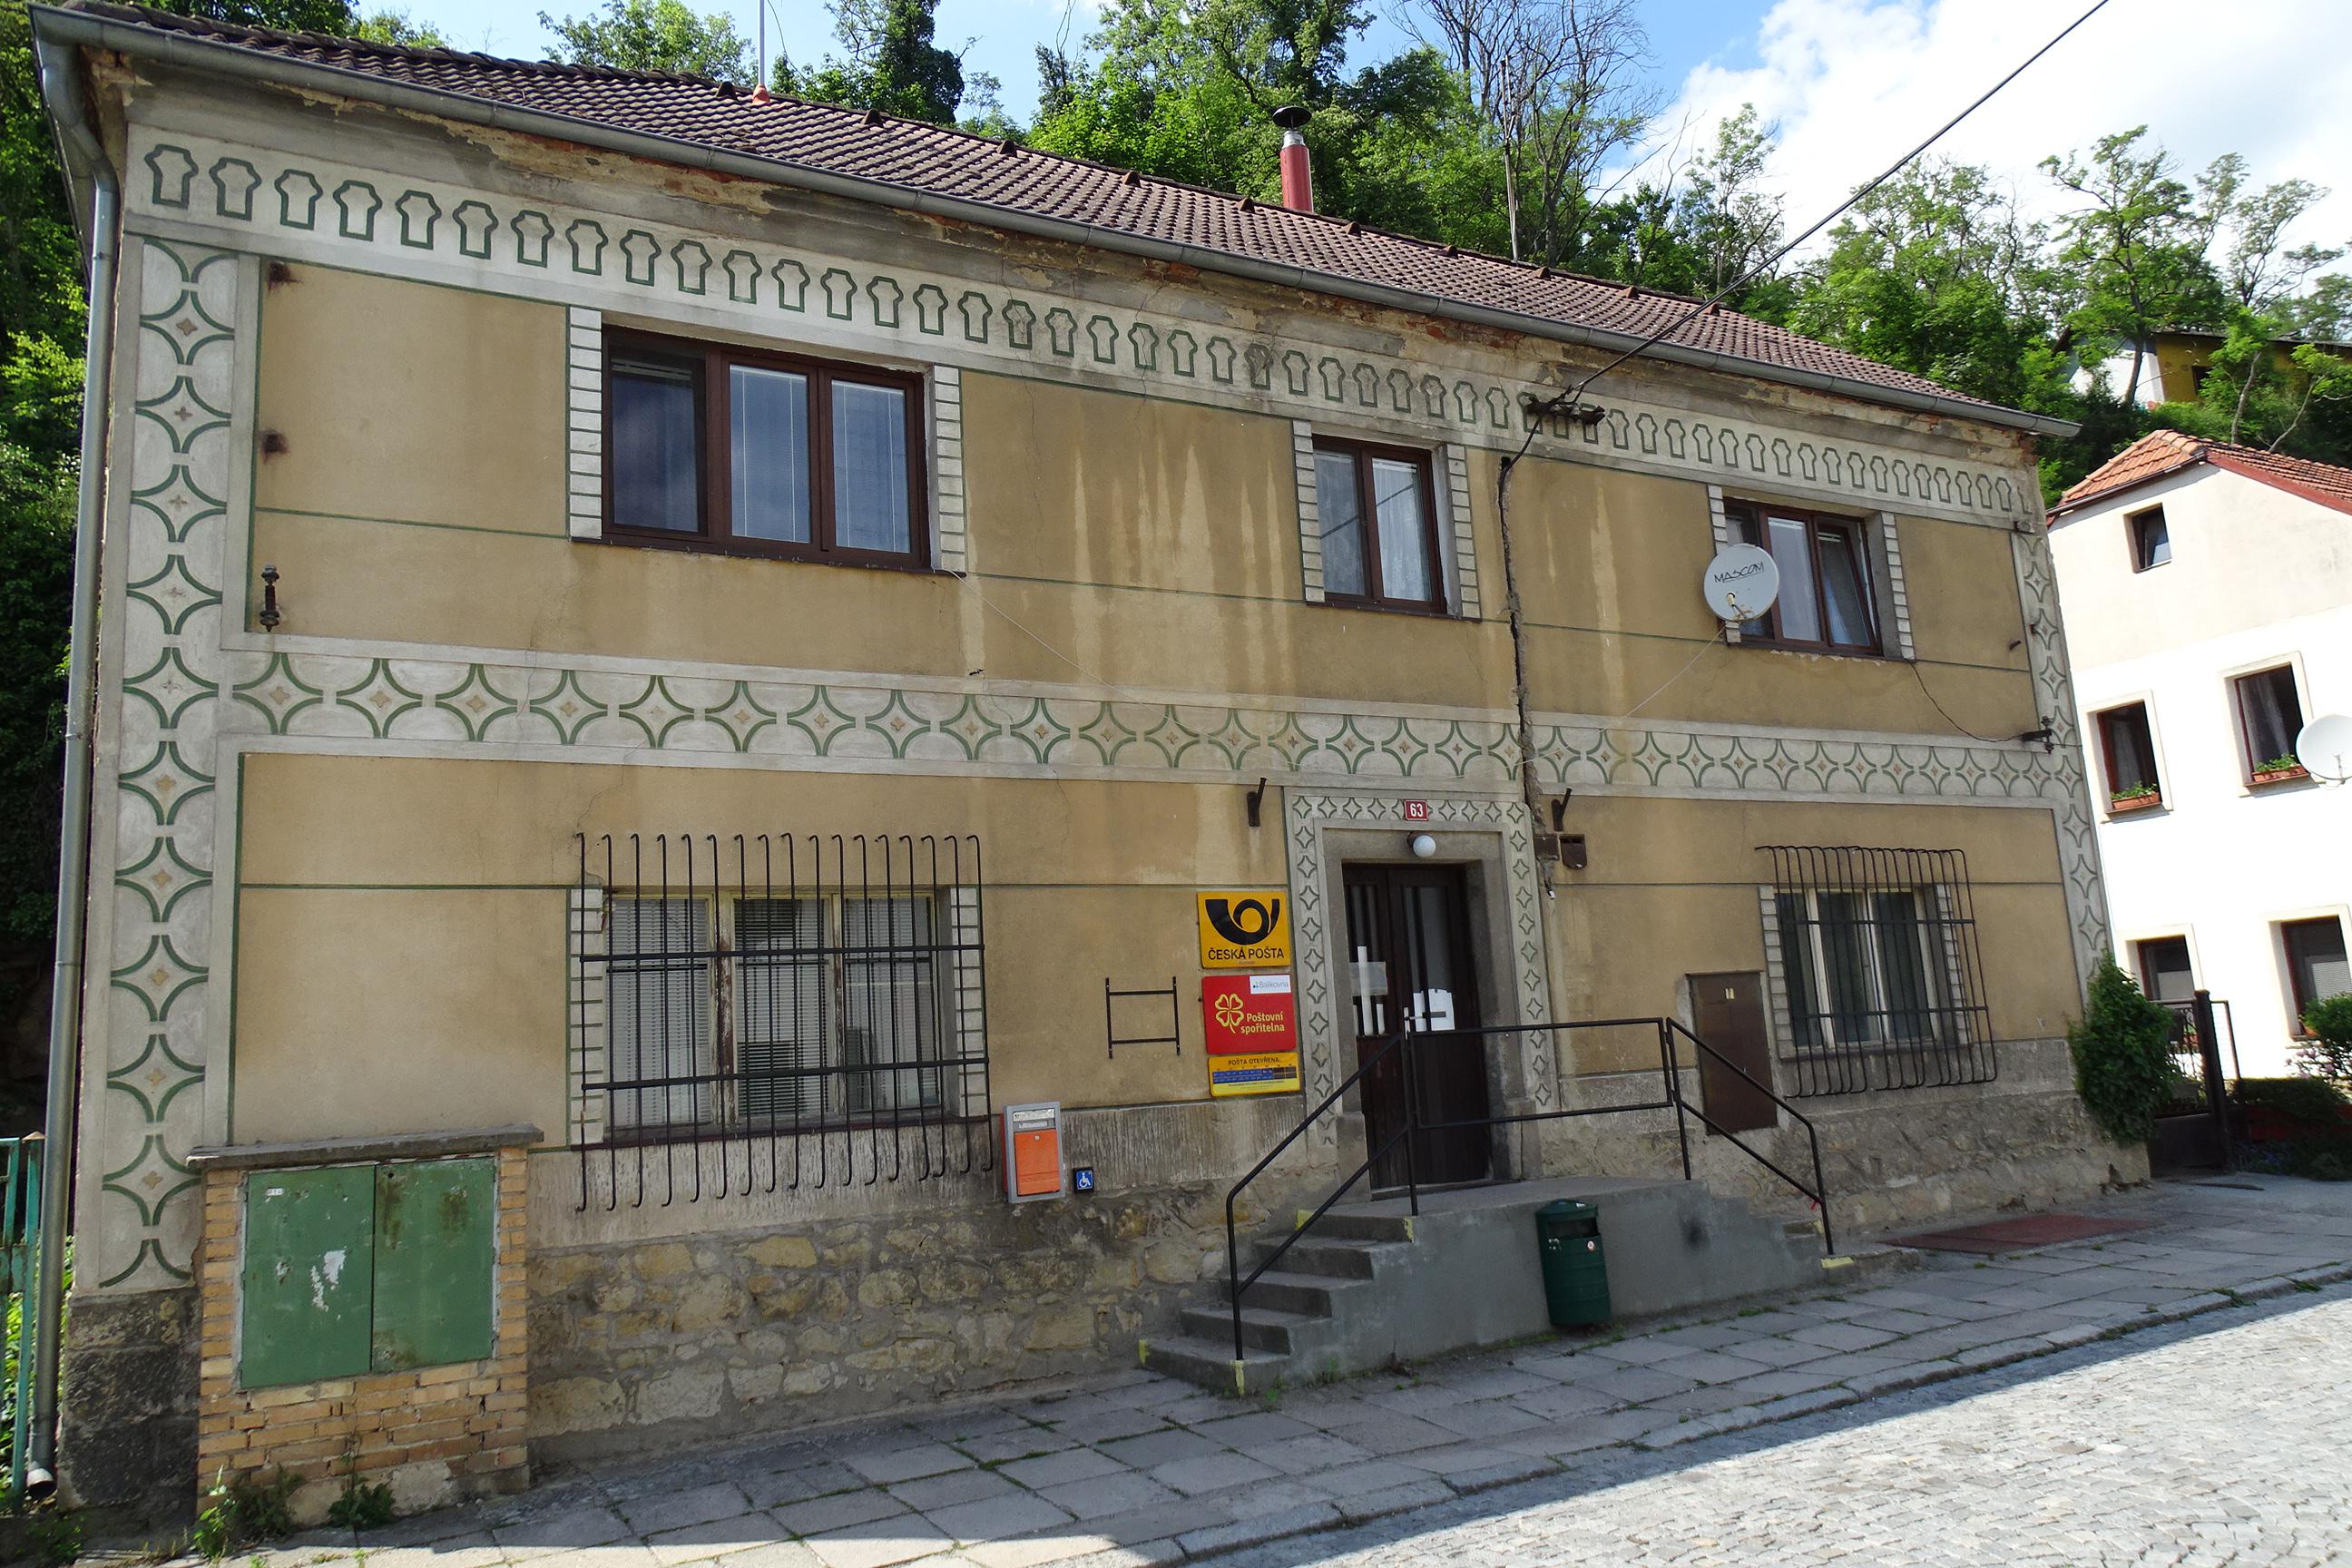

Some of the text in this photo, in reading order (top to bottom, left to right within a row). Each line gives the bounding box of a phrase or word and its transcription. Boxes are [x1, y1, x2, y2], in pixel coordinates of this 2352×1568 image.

[1713, 561, 1765, 583] MASCOM
[1409, 802, 1424, 818] 63
[1208, 946, 1285, 960] ČESKÁ POŠTA
[1246, 1011, 1284, 1023] Poštovní
[1240, 1023, 1285, 1035] spořitelna
[1228, 1058, 1248, 1066] POŠTA
